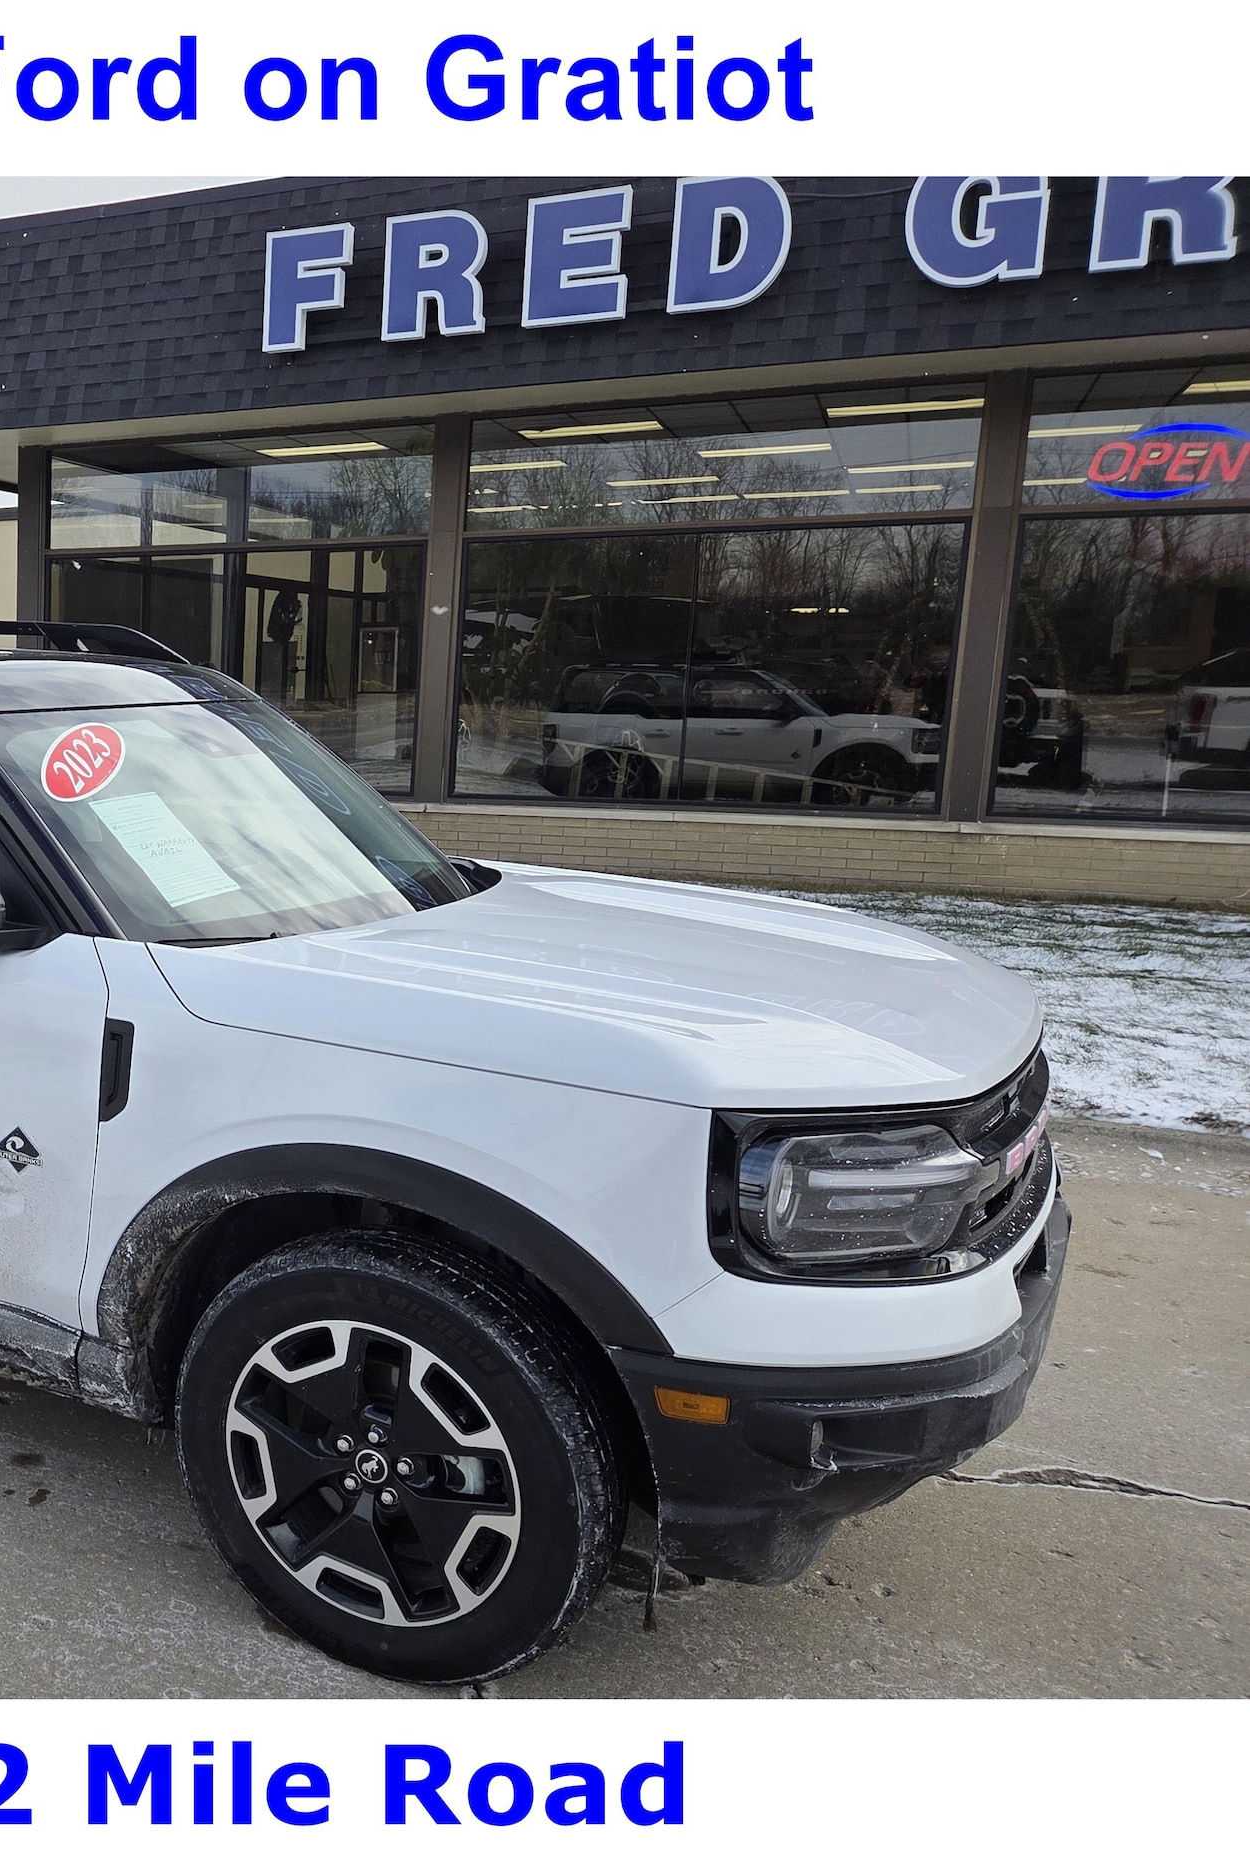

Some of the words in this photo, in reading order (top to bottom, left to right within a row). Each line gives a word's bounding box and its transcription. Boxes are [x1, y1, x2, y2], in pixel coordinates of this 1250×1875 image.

[262, 176, 792, 354] FRED
[1088, 441, 1250, 482] OPEN
[53, 729, 110, 794] 2023
[385, 1293, 501, 1372] MICHELIN
